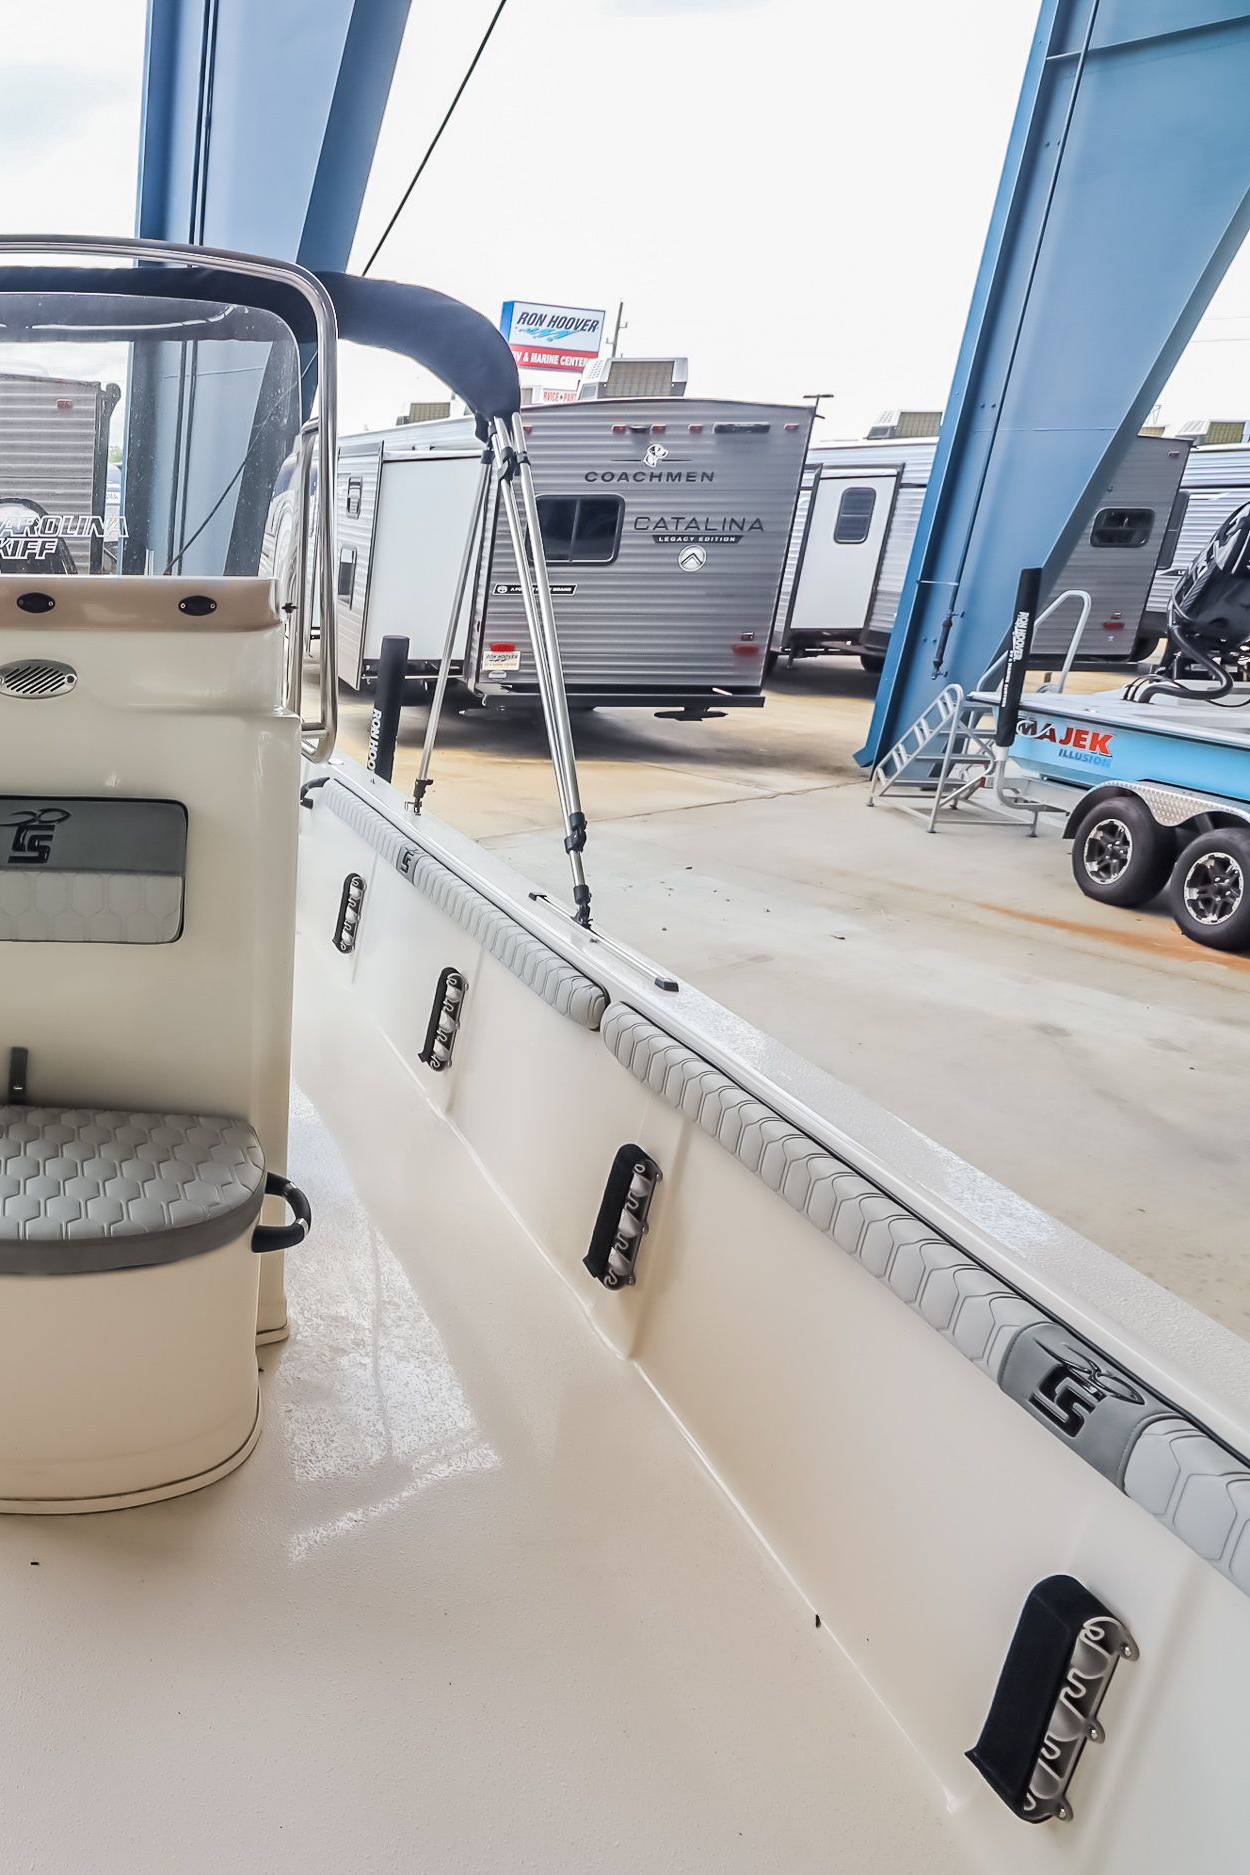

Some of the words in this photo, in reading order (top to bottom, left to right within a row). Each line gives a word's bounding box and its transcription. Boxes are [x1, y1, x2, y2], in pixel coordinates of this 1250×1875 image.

[517, 312, 547, 327] RON
[547, 315, 599, 333] HOOVER
[523, 352, 529, 362] &
[530, 353, 559, 365] MARINE
[584, 471, 715, 482] COACHMEN
[633, 516, 765, 532] CATALINA
[371, 708, 382, 739] RON
[1058, 748, 1112, 768] ILLUSION
